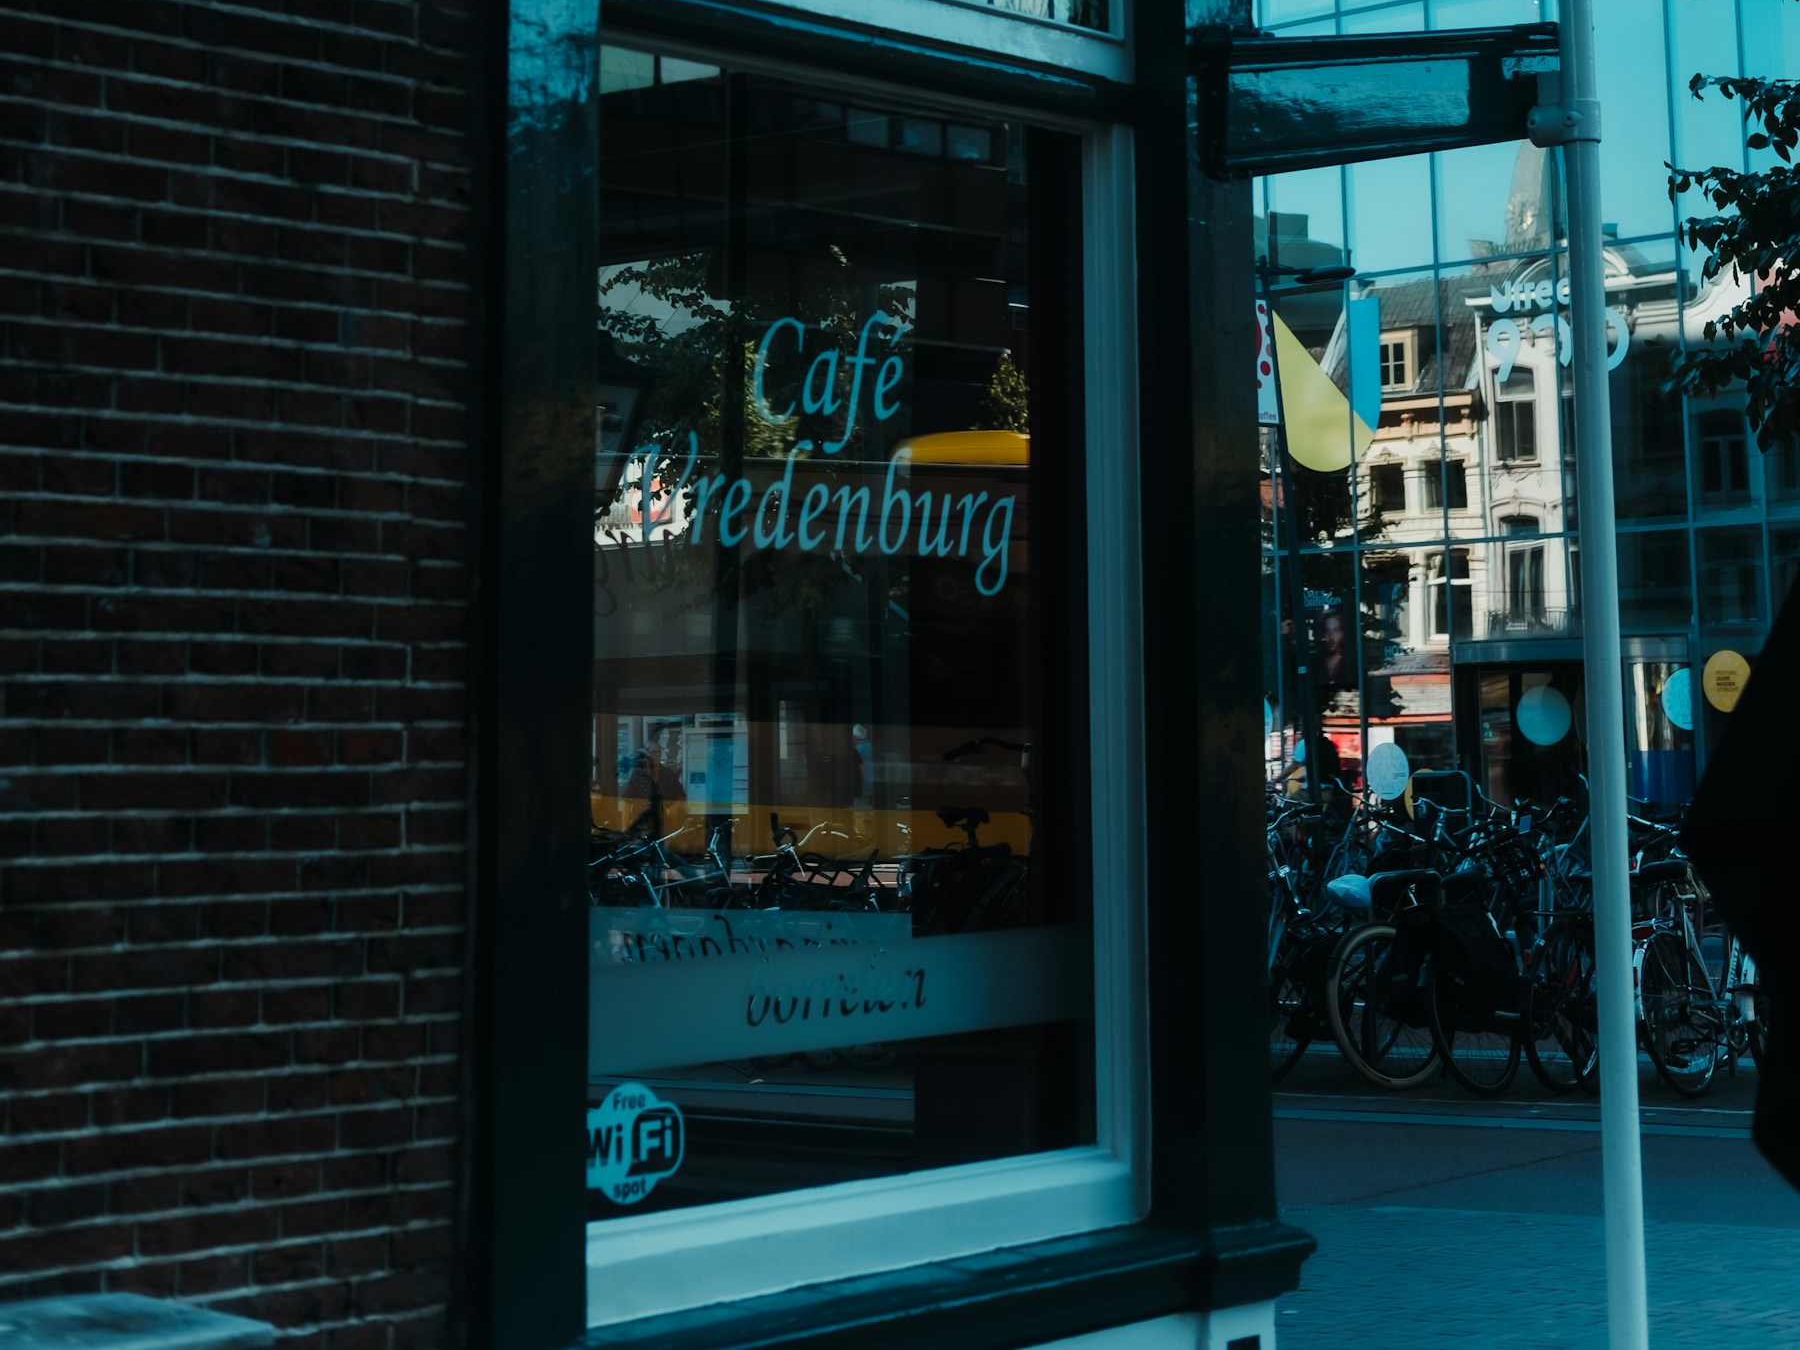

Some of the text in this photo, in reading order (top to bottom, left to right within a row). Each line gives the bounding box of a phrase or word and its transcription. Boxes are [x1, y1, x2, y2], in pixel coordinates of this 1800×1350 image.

[753, 310, 909, 455] Café
[622, 429, 1017, 597] Vredenburg
[613, 1092, 647, 1111] Free
[613, 1178, 647, 1202] spot
